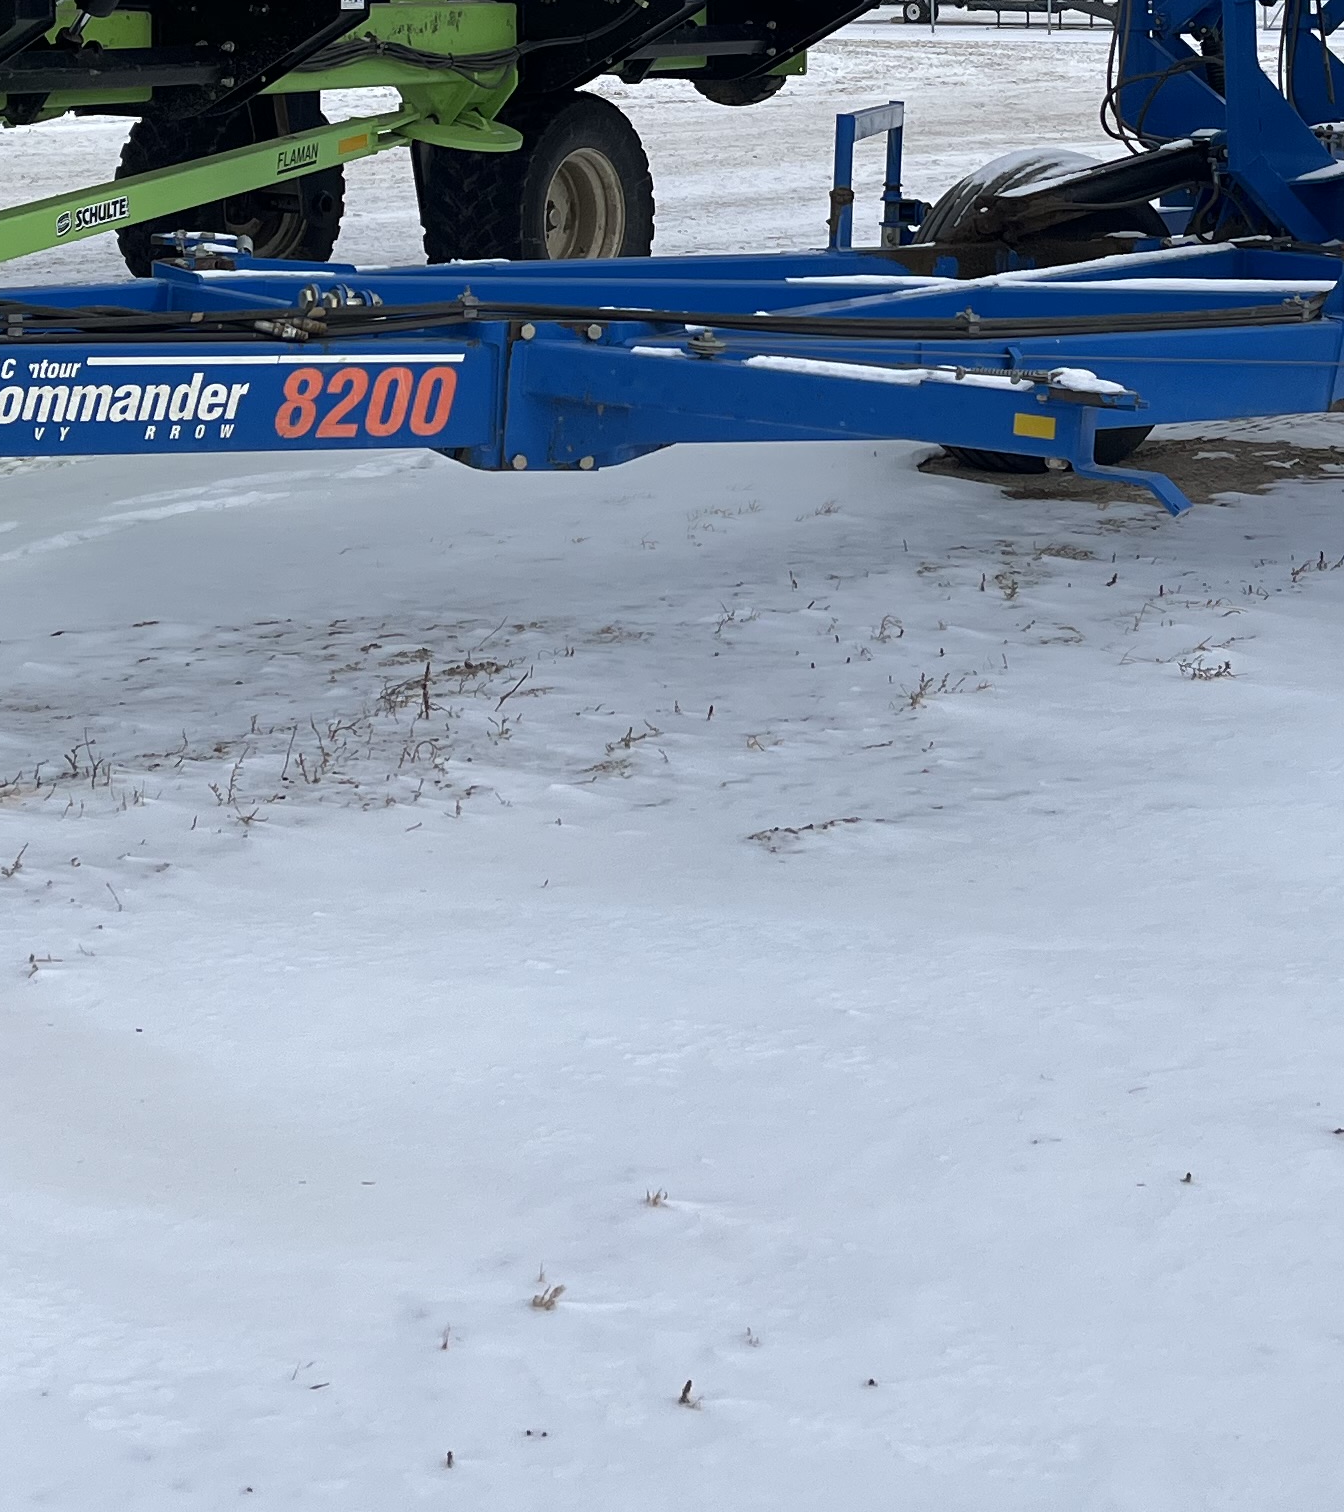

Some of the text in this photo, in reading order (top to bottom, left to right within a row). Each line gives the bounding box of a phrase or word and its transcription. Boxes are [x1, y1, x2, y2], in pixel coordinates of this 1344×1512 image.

[277, 142, 319, 170] FLAMAN
[75, 196, 128, 229] SCHULTE
[1, 359, 82, 379] Cntour
[275, 366, 457, 438] 8200
